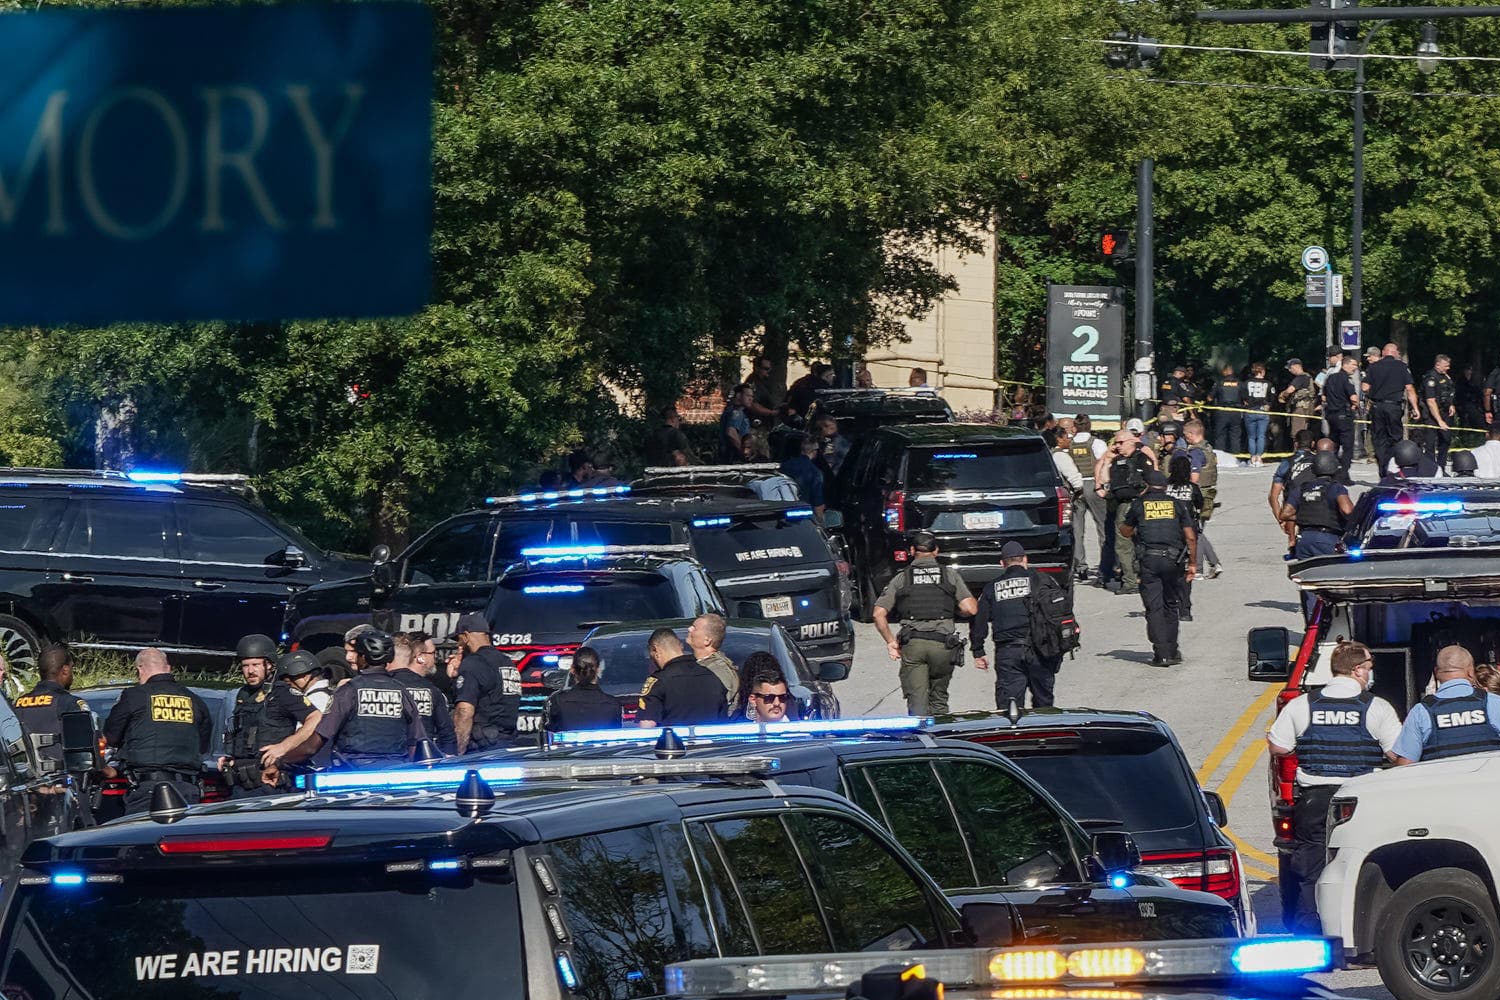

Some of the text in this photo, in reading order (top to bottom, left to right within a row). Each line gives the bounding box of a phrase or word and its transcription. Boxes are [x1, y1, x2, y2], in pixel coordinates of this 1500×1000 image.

[1071, 325, 1099, 362] 2
[1063, 374, 1108, 388] FREE
[1062, 389, 1108, 399] PARKING
[1145, 510, 1174, 519] POLICE
[996, 578, 1029, 592] ATLANTA
[997, 588, 1030, 601] POLICE
[801, 621, 839, 640] POLICE
[492, 633, 532, 646] 36128
[16, 696, 54, 707] POLICE
[153, 696, 192, 709] ATLANTA
[360, 690, 401, 703] ATLANTA
[154, 707, 193, 721] POLICE
[360, 703, 401, 717] POLICE
[1312, 711, 1360, 725] EMS
[1437, 710, 1485, 728] EMS
[135, 947, 342, 980] WE ARE HIRING
